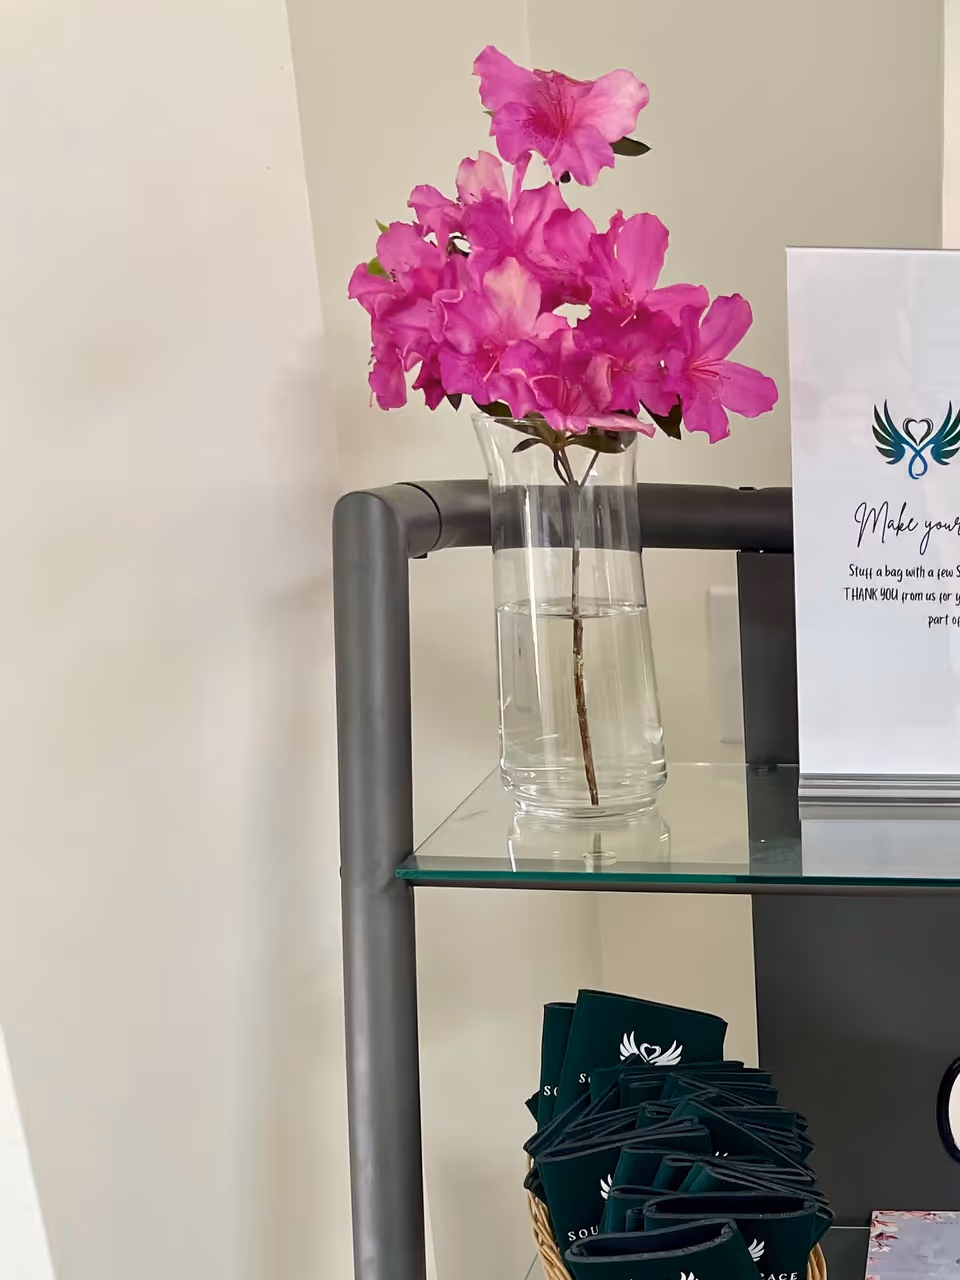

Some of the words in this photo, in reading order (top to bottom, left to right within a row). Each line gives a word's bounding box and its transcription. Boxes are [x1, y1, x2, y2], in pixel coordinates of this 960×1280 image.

[854, 501, 919, 548] Make
[849, 563, 873, 579] Stuff
[876, 568, 883, 577] a
[885, 564, 903, 582] bag
[905, 565, 925, 578] with
[928, 568, 935, 578] a
[937, 568, 954, 580] few
[843, 587, 878, 602] THANK
[880, 587, 899, 601] YOU
[901, 591, 923, 604] from
[925, 592, 936, 602] us
[939, 591, 952, 604] for
[928, 614, 949, 629] part
[951, 616, 960, 628] of
